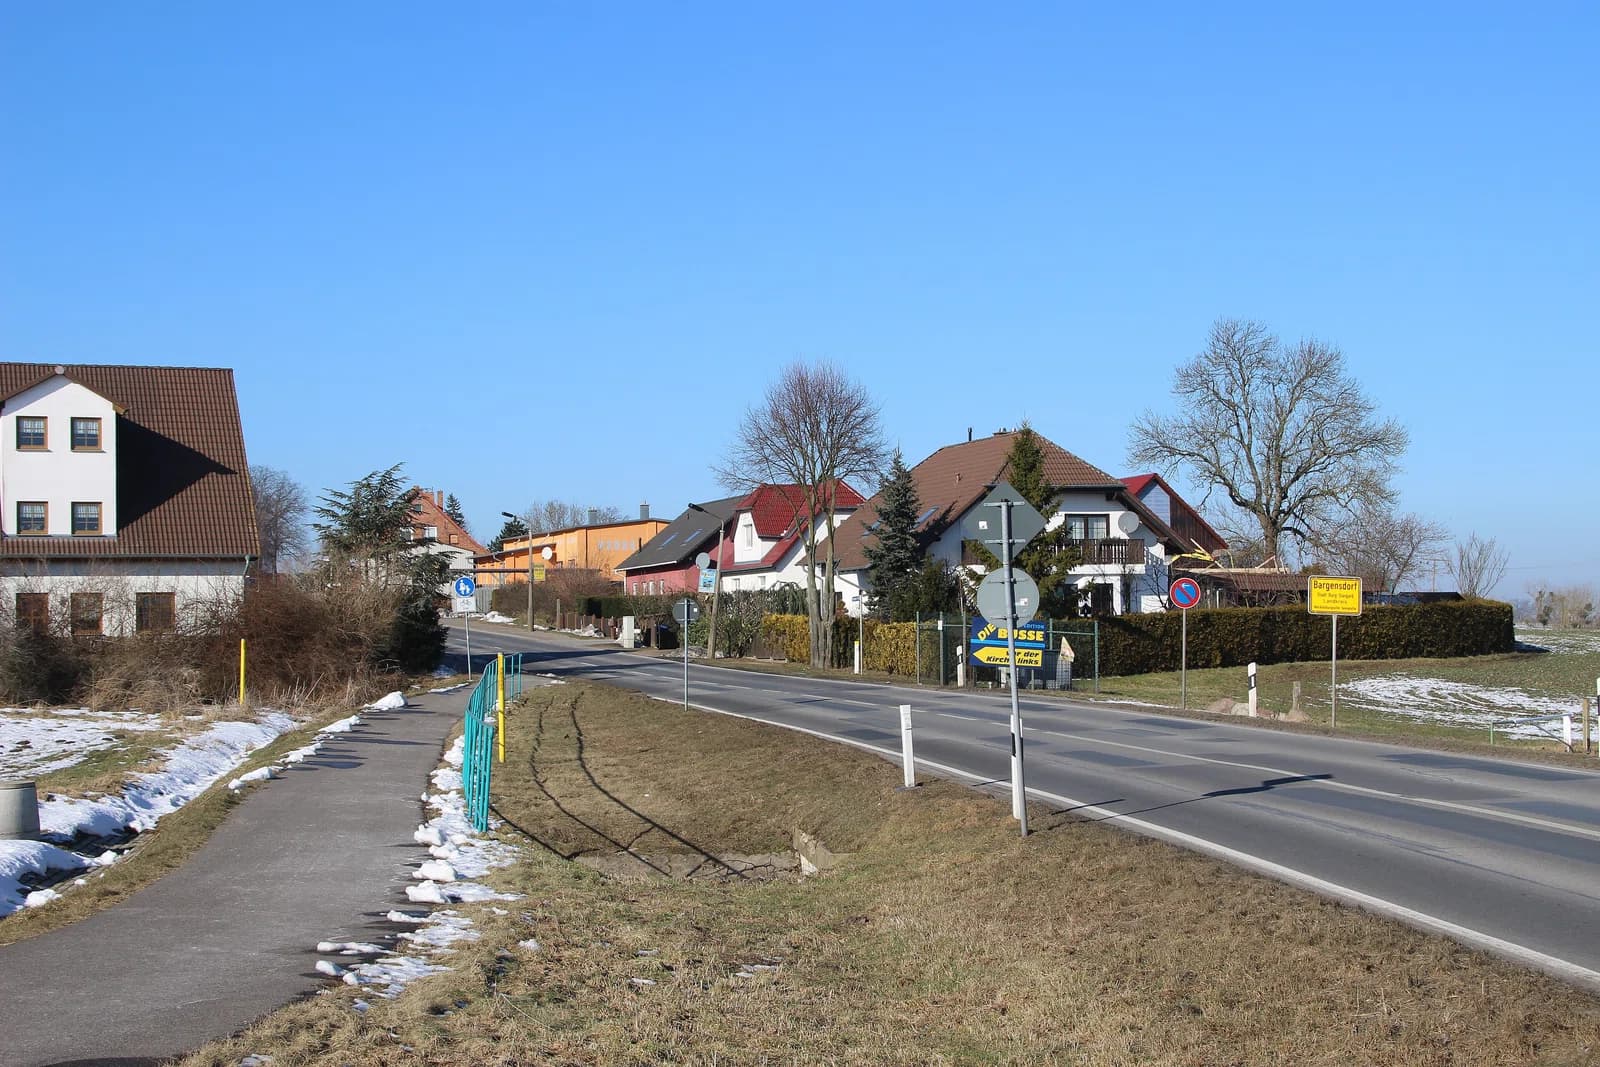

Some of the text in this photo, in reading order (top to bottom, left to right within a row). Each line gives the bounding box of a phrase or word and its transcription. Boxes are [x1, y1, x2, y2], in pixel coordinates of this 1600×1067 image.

[1313, 580, 1358, 591] Bargensdorf
[977, 623, 997, 641] DIE
[986, 656, 1012, 664] Kirch
